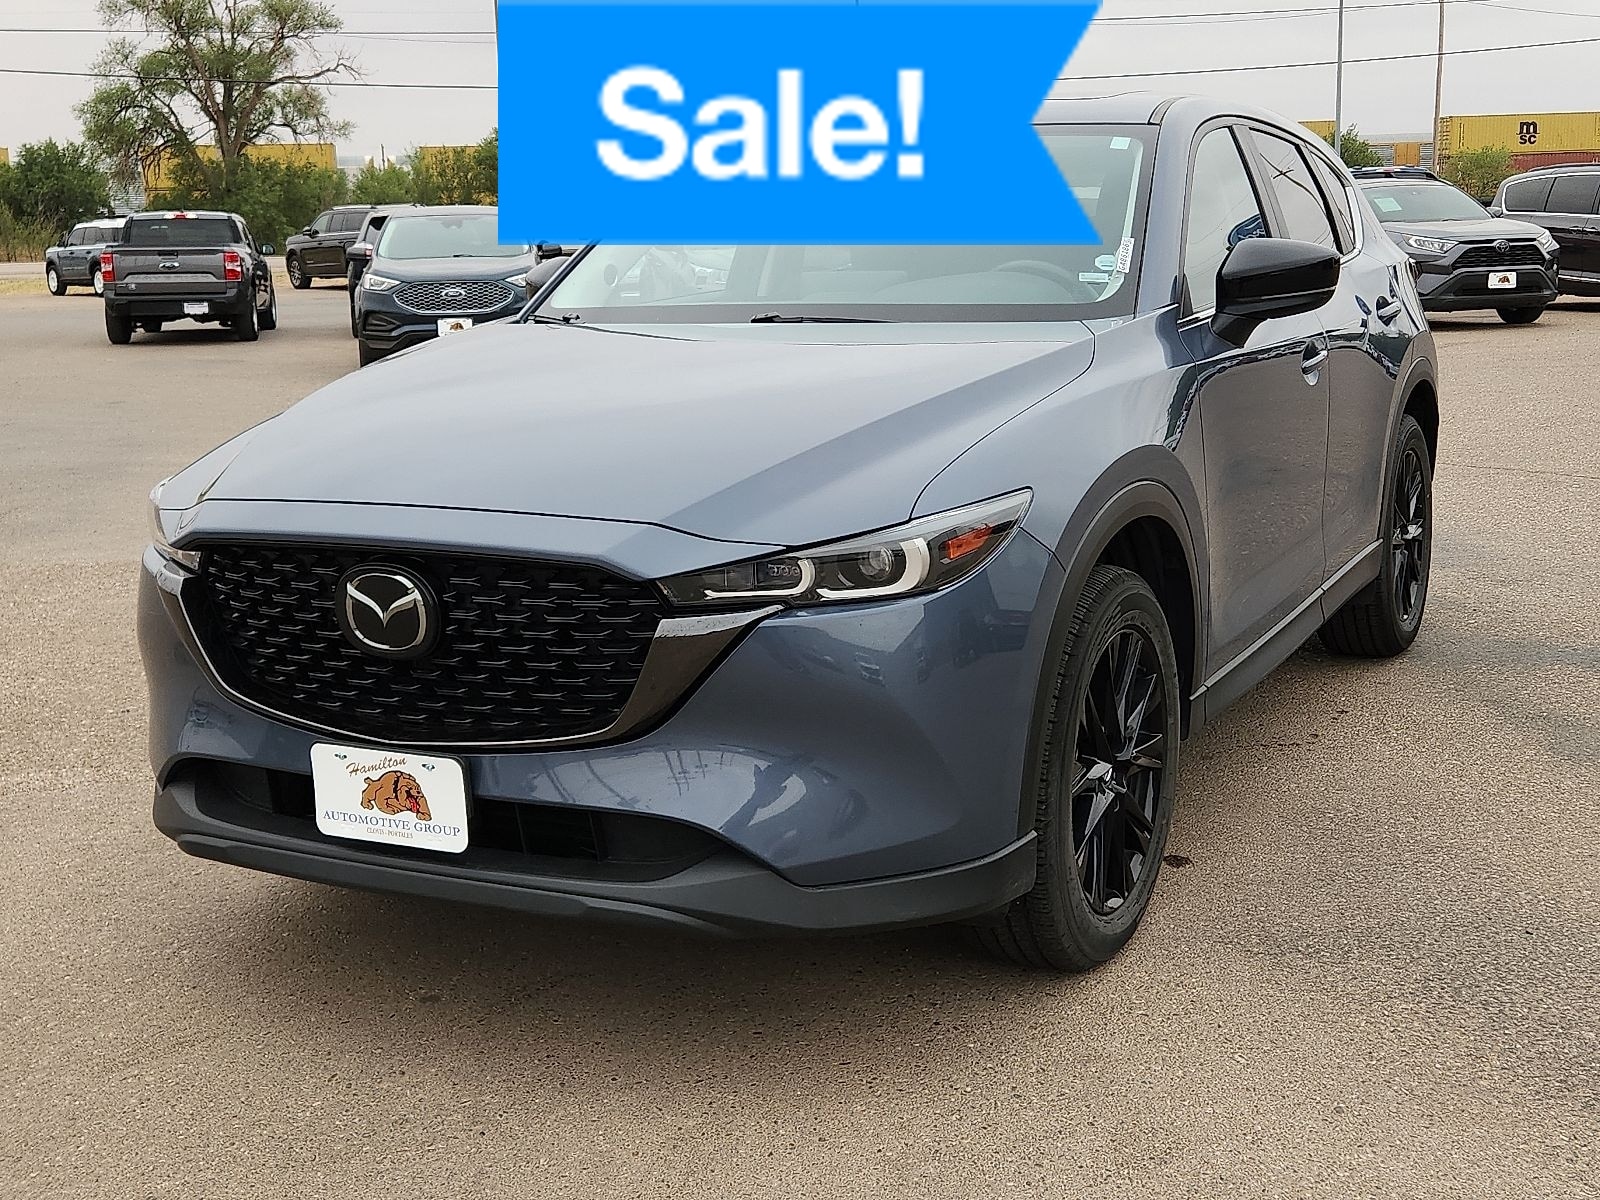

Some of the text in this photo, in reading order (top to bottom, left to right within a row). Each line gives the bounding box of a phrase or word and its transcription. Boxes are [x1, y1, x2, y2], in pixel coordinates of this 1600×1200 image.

[346, 756, 408, 776] Hamilton
[323, 810, 461, 837] AUTOMOTIVE GROUP
